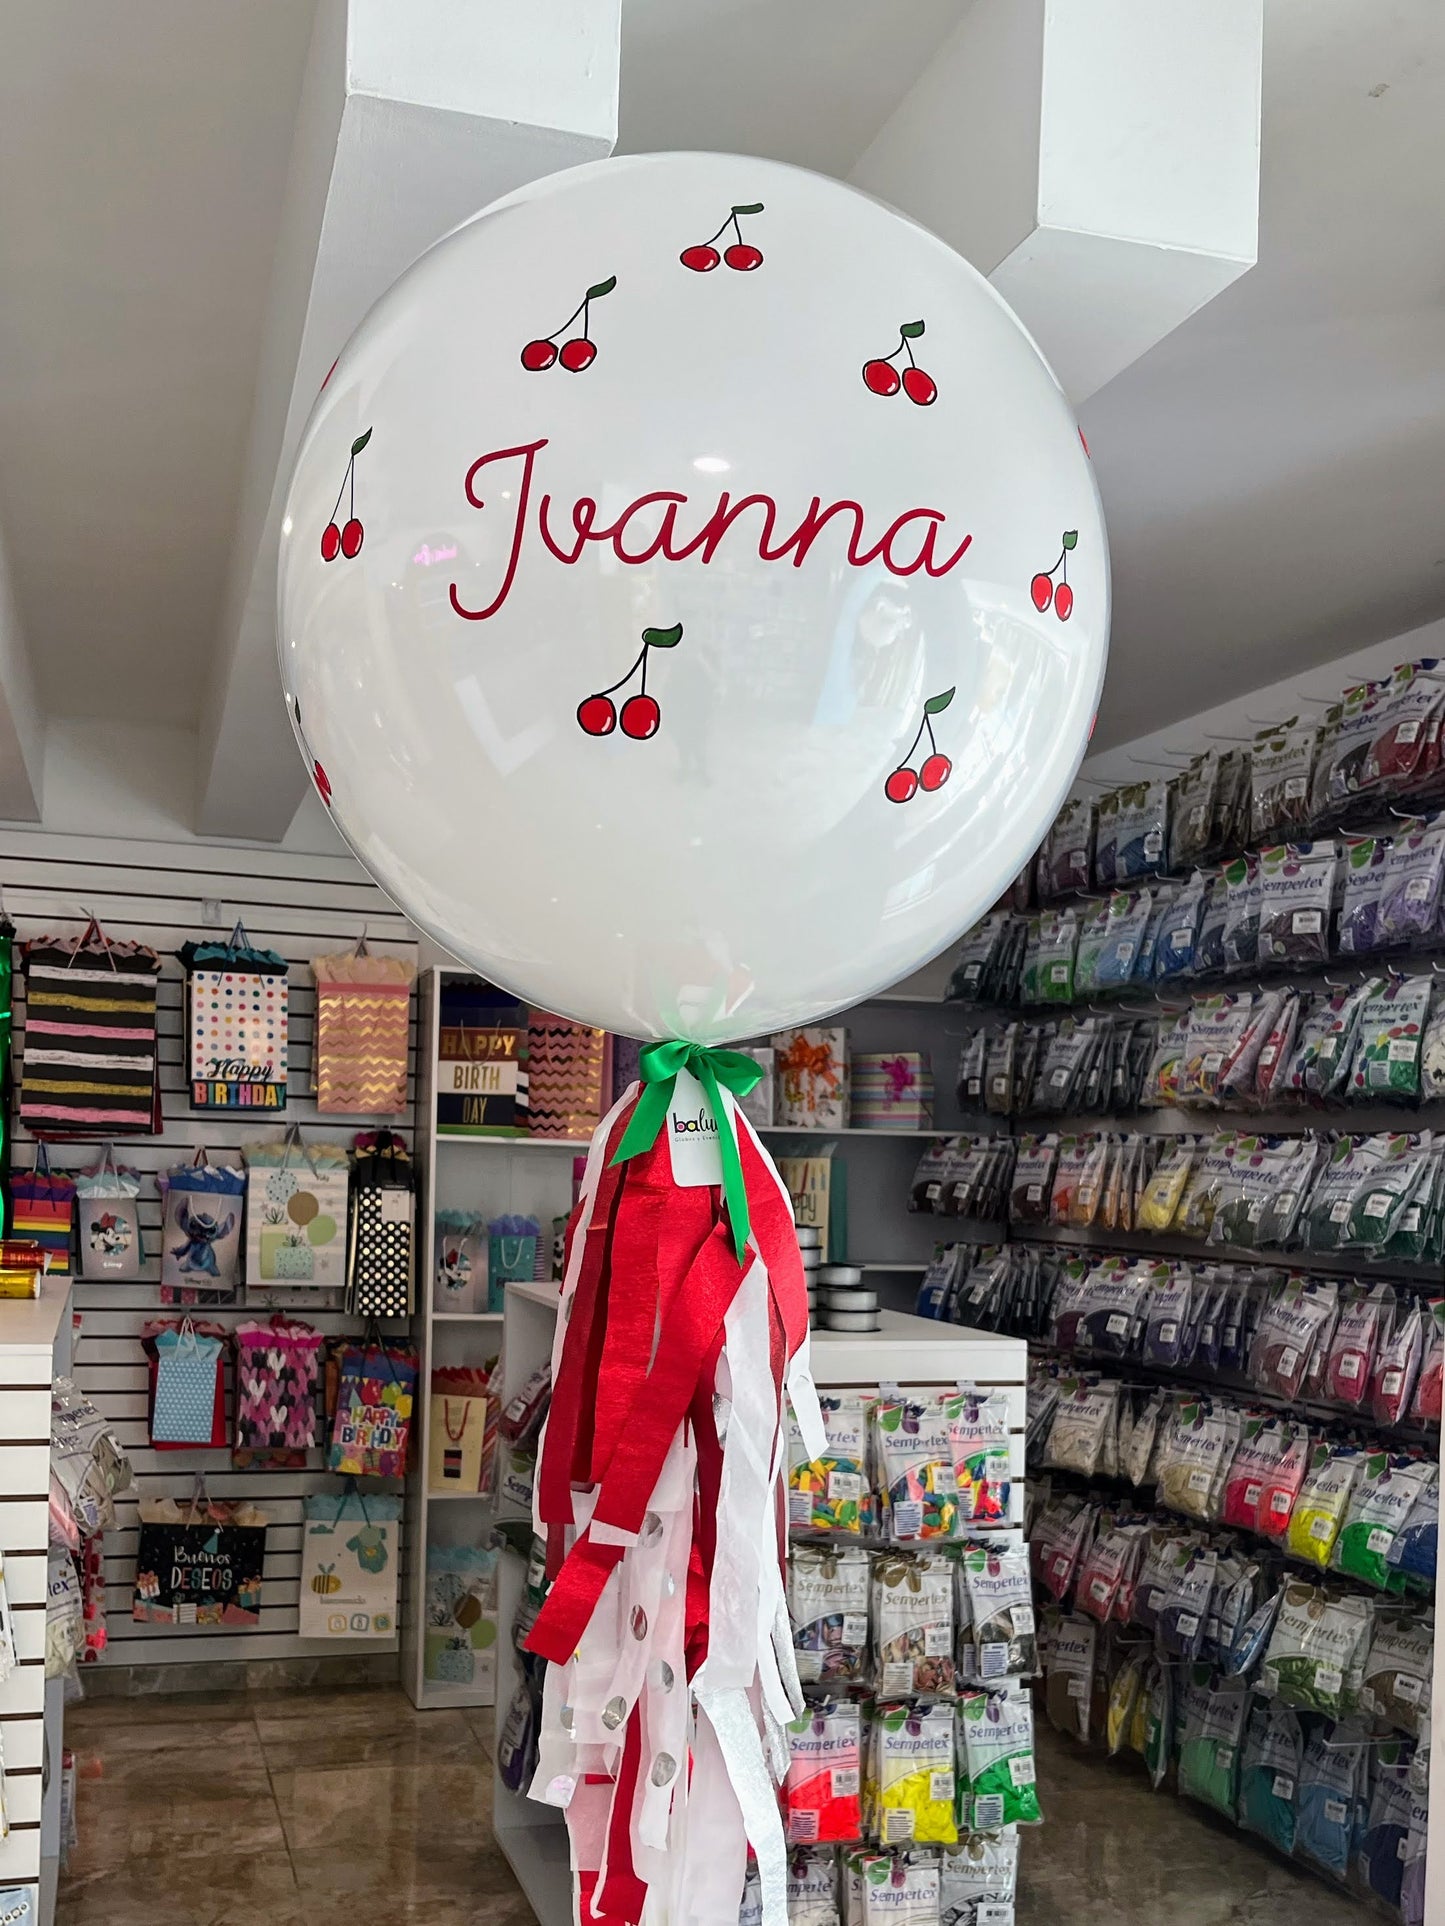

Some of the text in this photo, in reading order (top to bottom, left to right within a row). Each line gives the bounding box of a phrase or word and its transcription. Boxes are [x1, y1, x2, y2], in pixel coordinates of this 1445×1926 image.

[443, 1034, 516, 1056] HAPPY
[205, 1058, 274, 1082] Happy
[453, 1065, 501, 1091] BIRTH
[194, 1082, 286, 1107] BIRTHDAY
[462, 1097, 488, 1124] DAY
[350, 1405, 400, 1427] HAPPY
[341, 1423, 407, 1451] BIRTHDAY
[885, 1433, 949, 1450] Sempertex
[174, 1545, 231, 1565] Buenos
[171, 1566, 232, 1591] DESEOS
[972, 1574, 1029, 1593] Sempertex
[884, 1591, 949, 1609] Sempertex
[969, 1721, 1030, 1740] Sempertex
[791, 1735, 857, 1751] Sempertex
[885, 1736, 948, 1751] Sempertex
[869, 1888, 937, 1906] Sempertex
